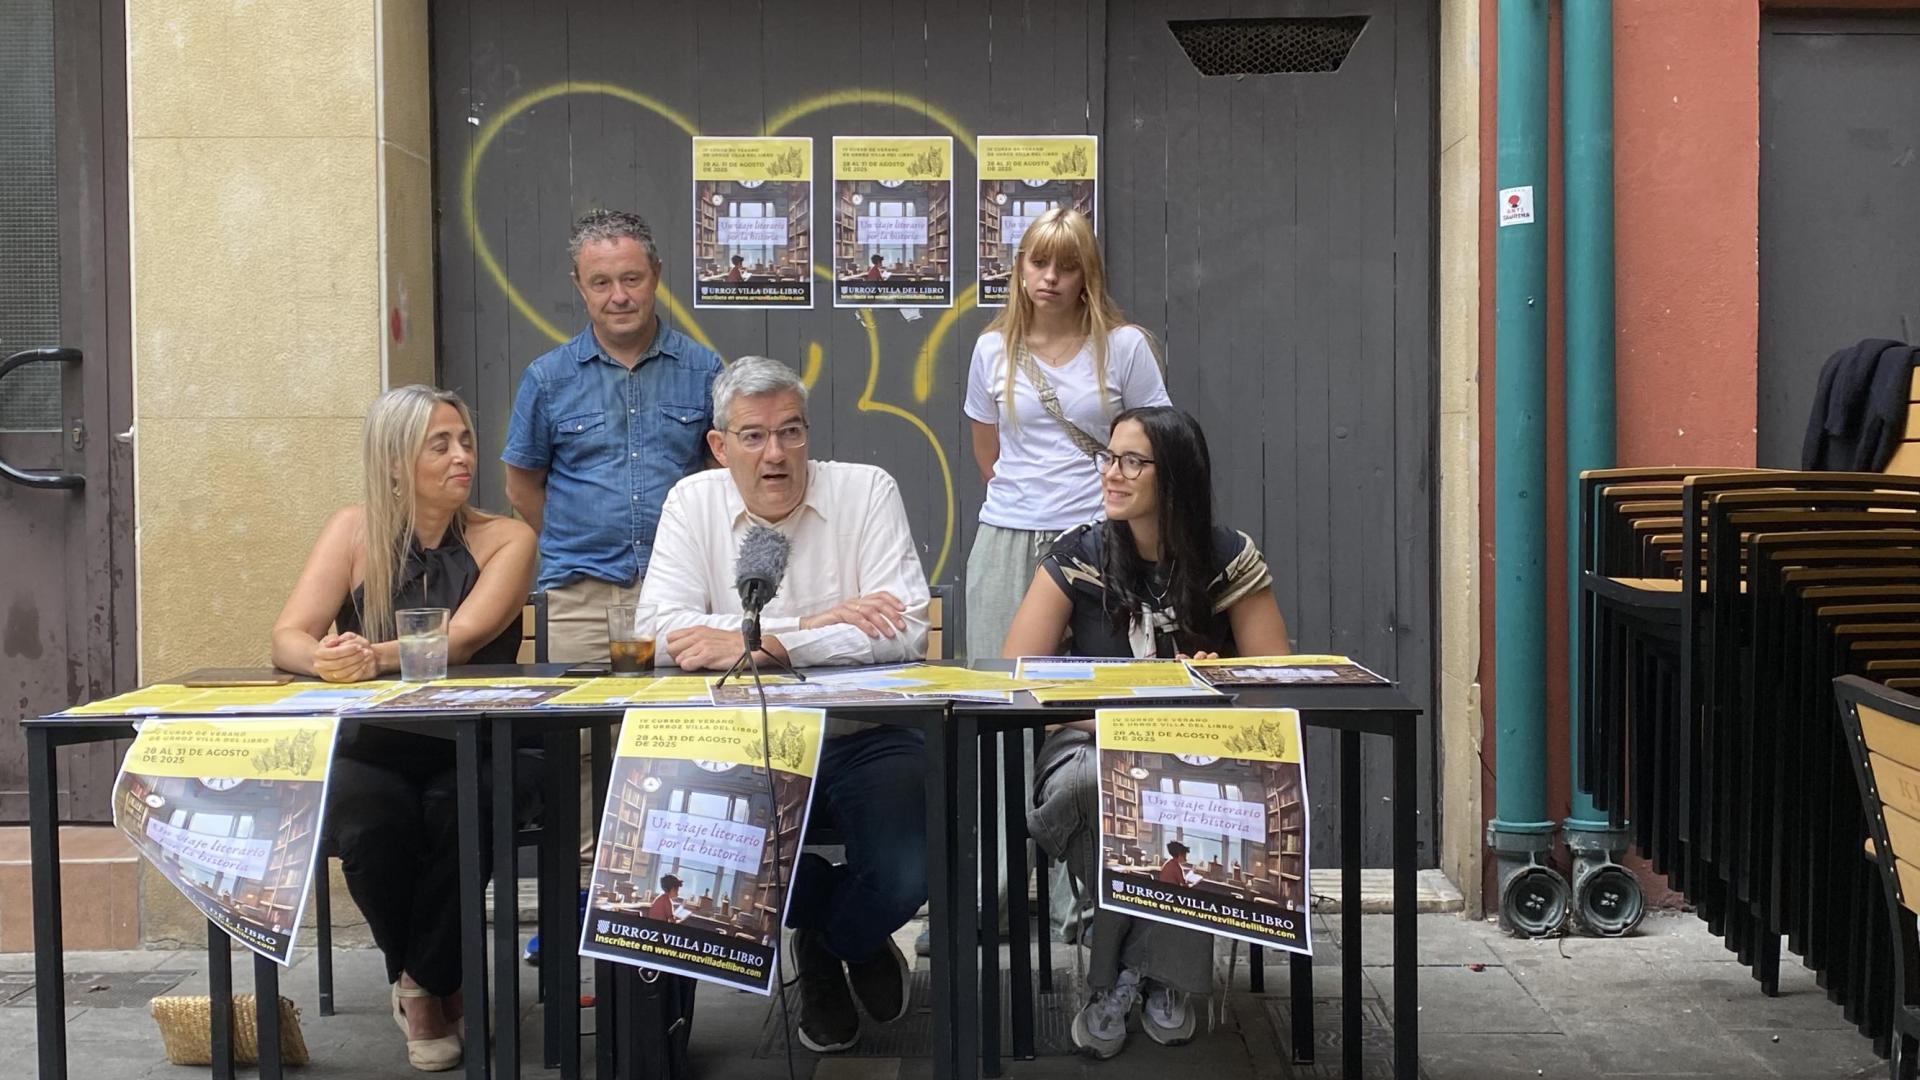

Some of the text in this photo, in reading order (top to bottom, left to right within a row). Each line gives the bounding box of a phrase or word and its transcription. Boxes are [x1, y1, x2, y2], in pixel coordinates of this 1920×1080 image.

[697, 736, 742, 744] AGOSTO
[1176, 732, 1219, 740] AGOSTO
[144, 747, 157, 755] 28
[160, 748, 173, 756] AL
[177, 748, 186, 756] 31
[206, 749, 250, 757] AGOSTO
[160, 756, 185, 764] 2025
[1148, 795, 1261, 818] Un viaje literario
[652, 816, 760, 847] Un viaje literario
[1158, 811, 1250, 832] por la historia
[657, 836, 746, 863] por la historia
[1126, 883, 1294, 930] URROZ VILLA DEL LIBRO
[1159, 902, 1171, 912] en
[1173, 906, 1296, 940] www.urrozvilladellibro.com
[236, 923, 277, 945] LIBRO
[611, 923, 764, 968] URROZ VILLA DEL LIBRO
[642, 944, 653, 953] en
[655, 946, 762, 978] www.urrozvilladellibro.com
